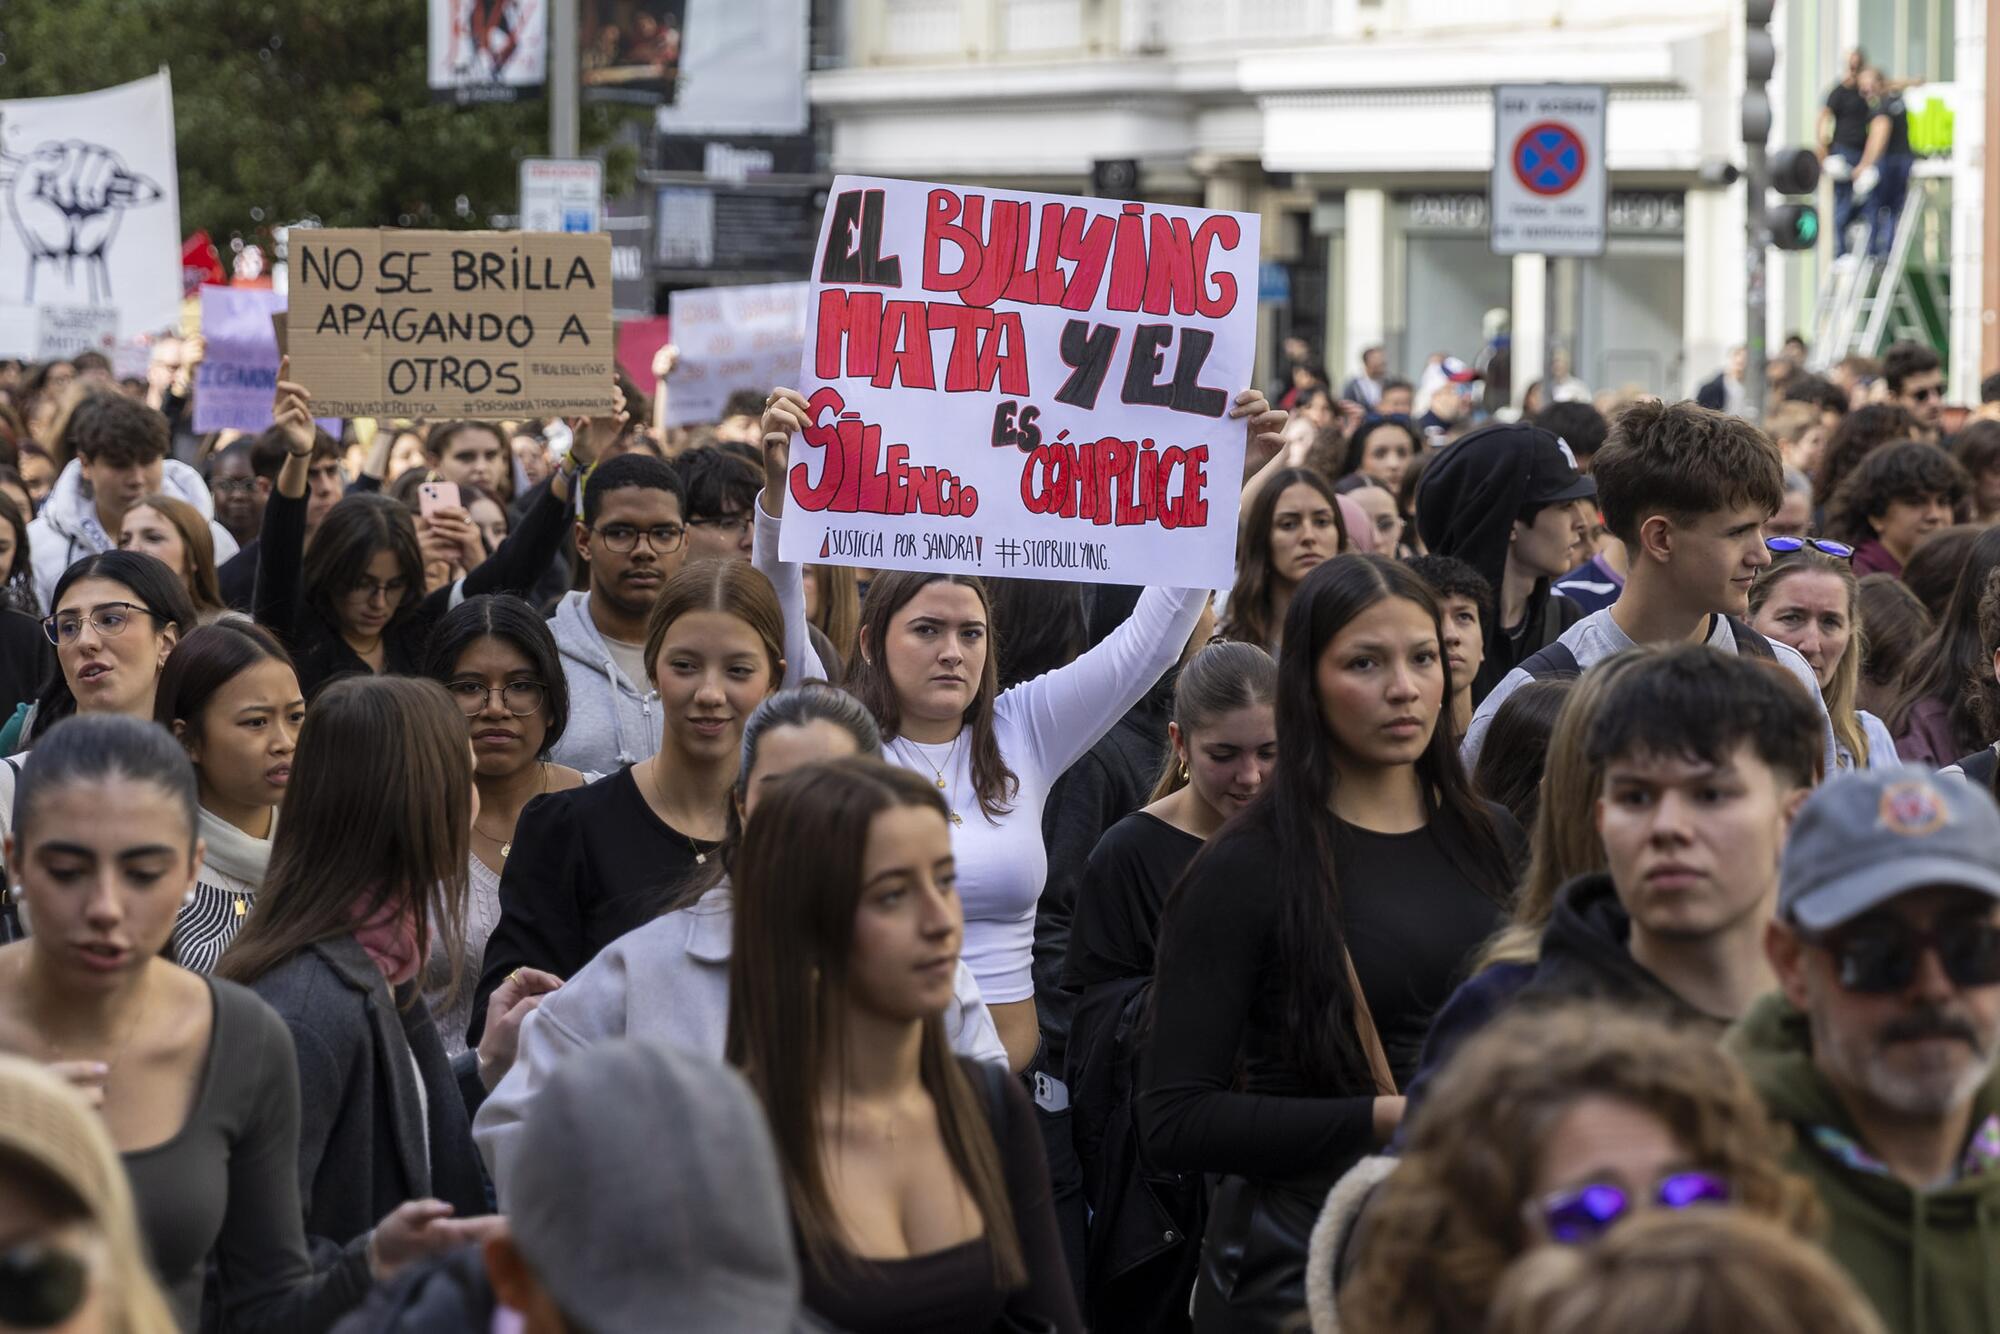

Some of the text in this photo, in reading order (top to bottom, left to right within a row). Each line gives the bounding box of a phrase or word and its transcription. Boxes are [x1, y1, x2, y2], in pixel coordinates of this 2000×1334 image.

[301, 245, 363, 292] NO
[375, 251, 432, 294] SE
[820, 188, 903, 288] EL
[922, 188, 1241, 319] BULLYING
[316, 303, 535, 349] APAGANDO
[558, 313, 591, 346] A
[388, 356, 522, 395] OTROS
[816, 289, 1229, 418] MATA Y EL
[789, 386, 1209, 530] SILENCIO ES CÓMPLICE
[893, 533, 917, 557] POR
[922, 533, 984, 567] SANDRA!
